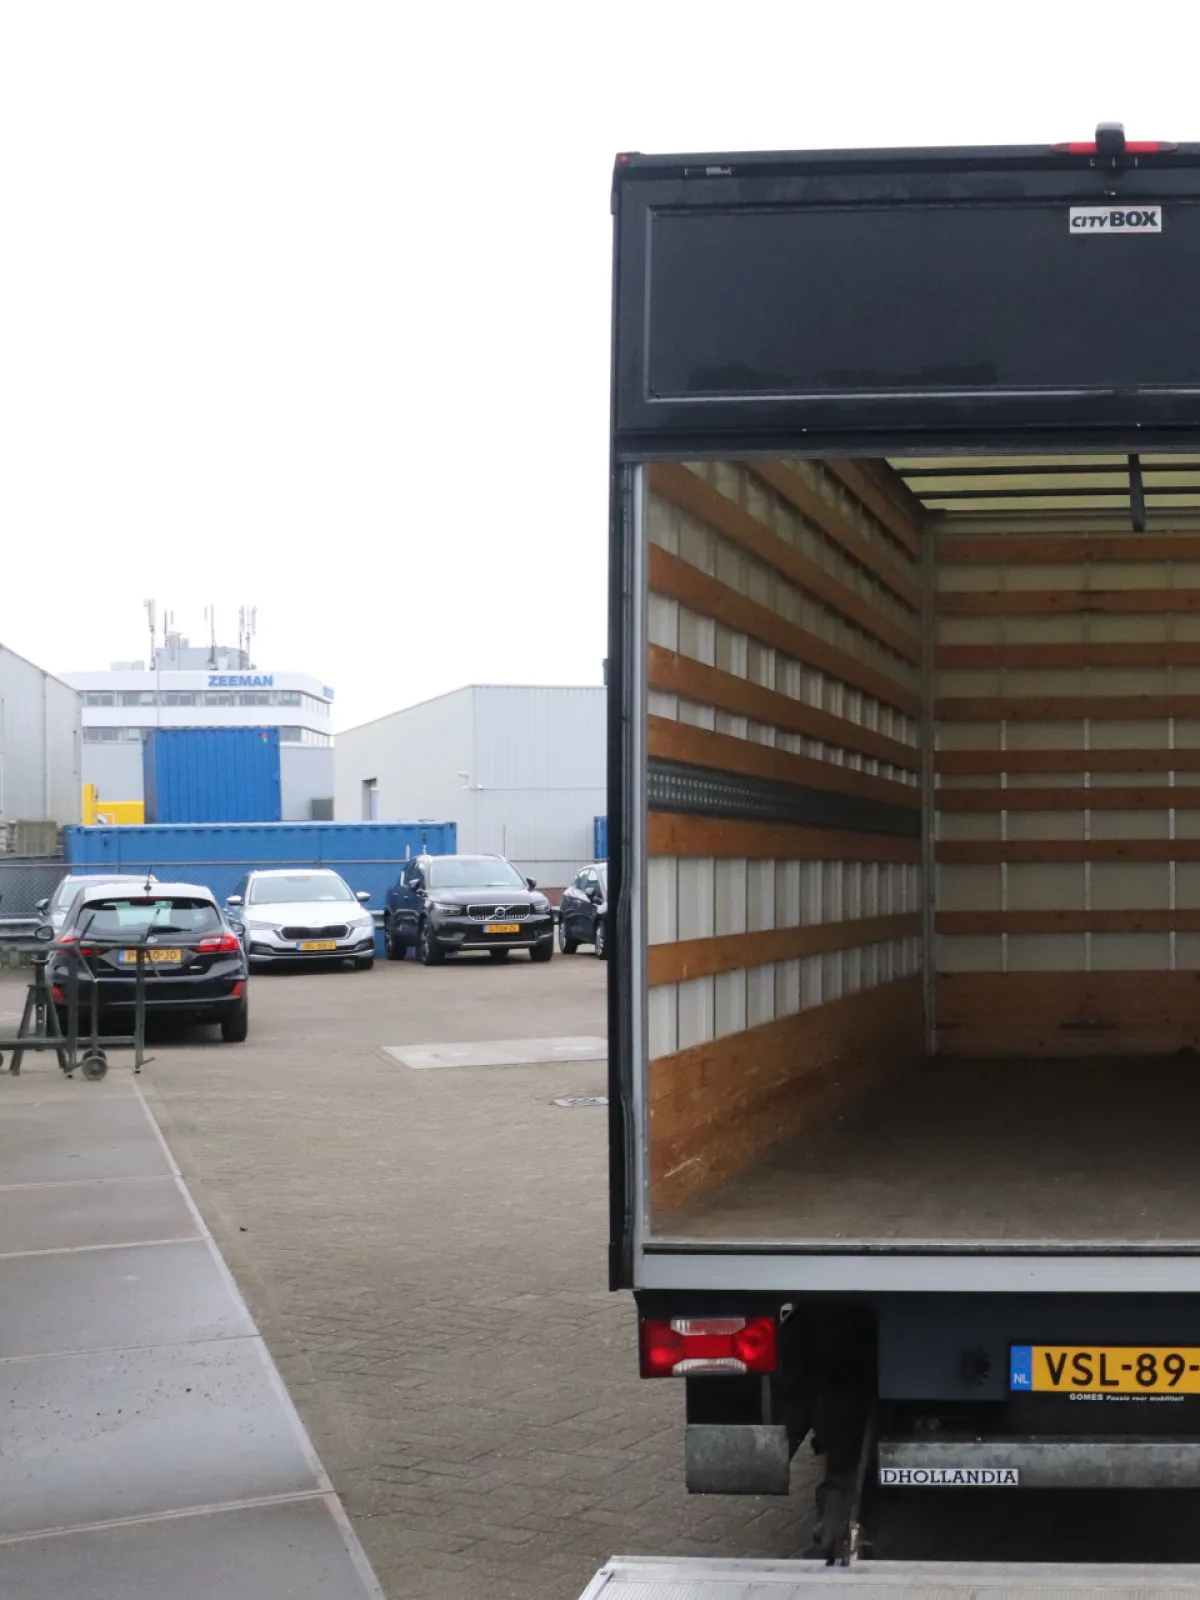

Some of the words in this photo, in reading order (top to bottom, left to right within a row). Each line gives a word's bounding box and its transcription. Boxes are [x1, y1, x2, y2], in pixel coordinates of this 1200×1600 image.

[208, 675, 273, 687] ZEEMAN
[1013, 1373, 1030, 1384] NL
[1069, 1393, 1103, 1401] GOMES
[883, 1469, 1017, 1483] DHOLLANDIA
